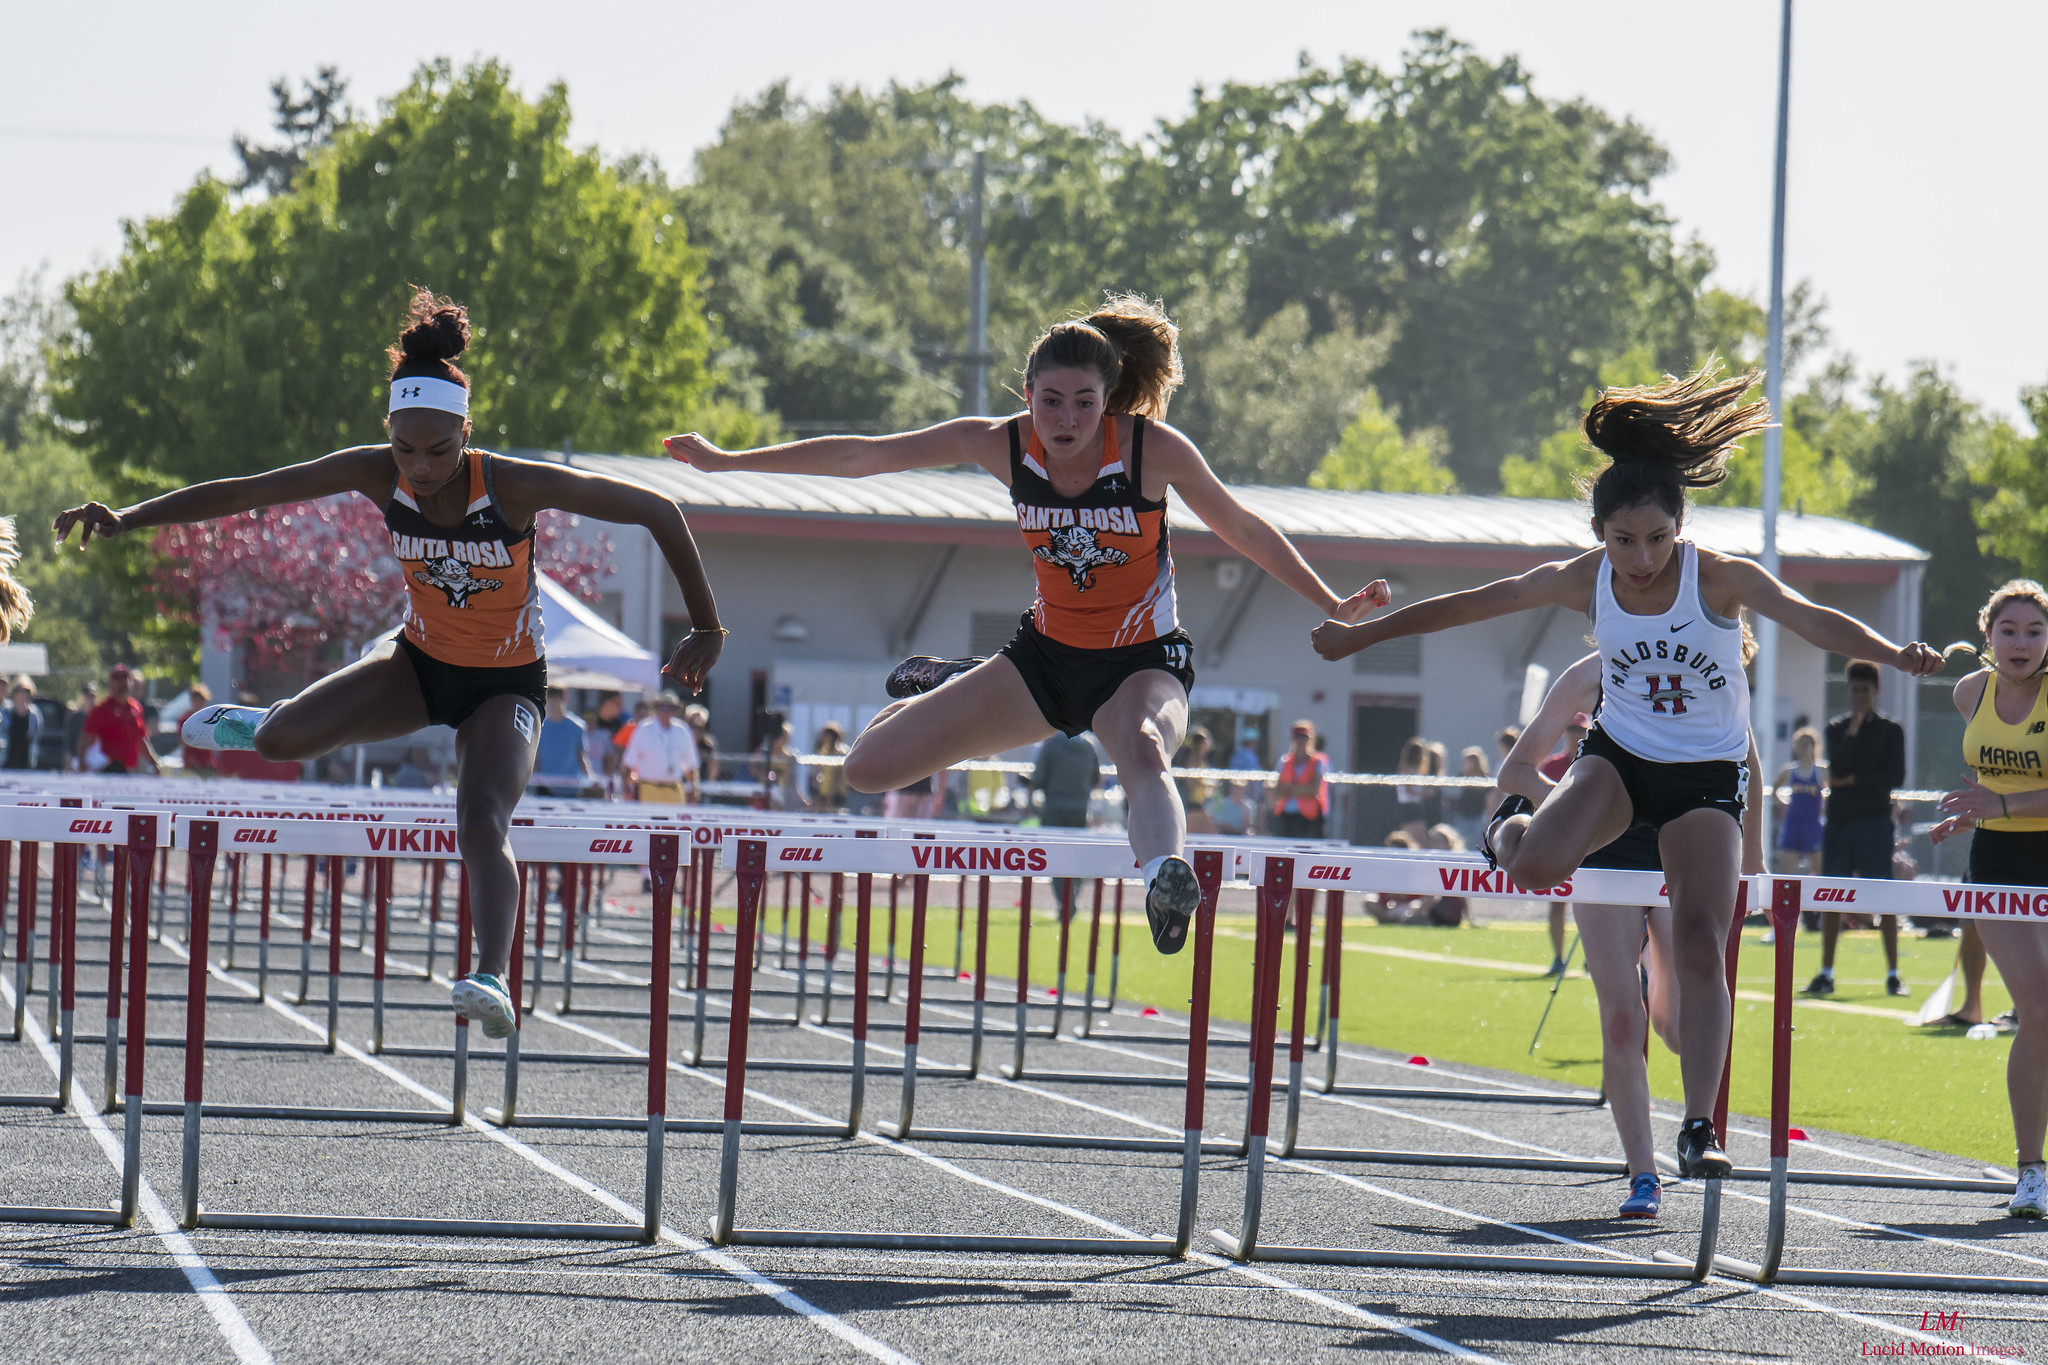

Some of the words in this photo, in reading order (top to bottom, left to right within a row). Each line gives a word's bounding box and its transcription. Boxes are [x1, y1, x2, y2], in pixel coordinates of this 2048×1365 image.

[1017, 502, 1075, 530] SANTA
[1079, 506, 1140, 534] ROSA
[392, 530, 449, 560] SANTA
[452, 539, 513, 568] ROSA
[1165, 644, 1184, 669] 4
[1979, 745, 2042, 769] MARIA
[69, 819, 113, 834] GILL
[234, 829, 277, 843] GILL
[366, 828, 457, 853] VIKIN
[590, 839, 633, 854] GILL
[779, 847, 823, 861] GILL
[911, 845, 1047, 872] VIKINGS
[1308, 865, 1352, 881] GILL
[1813, 888, 1856, 903] GILL
